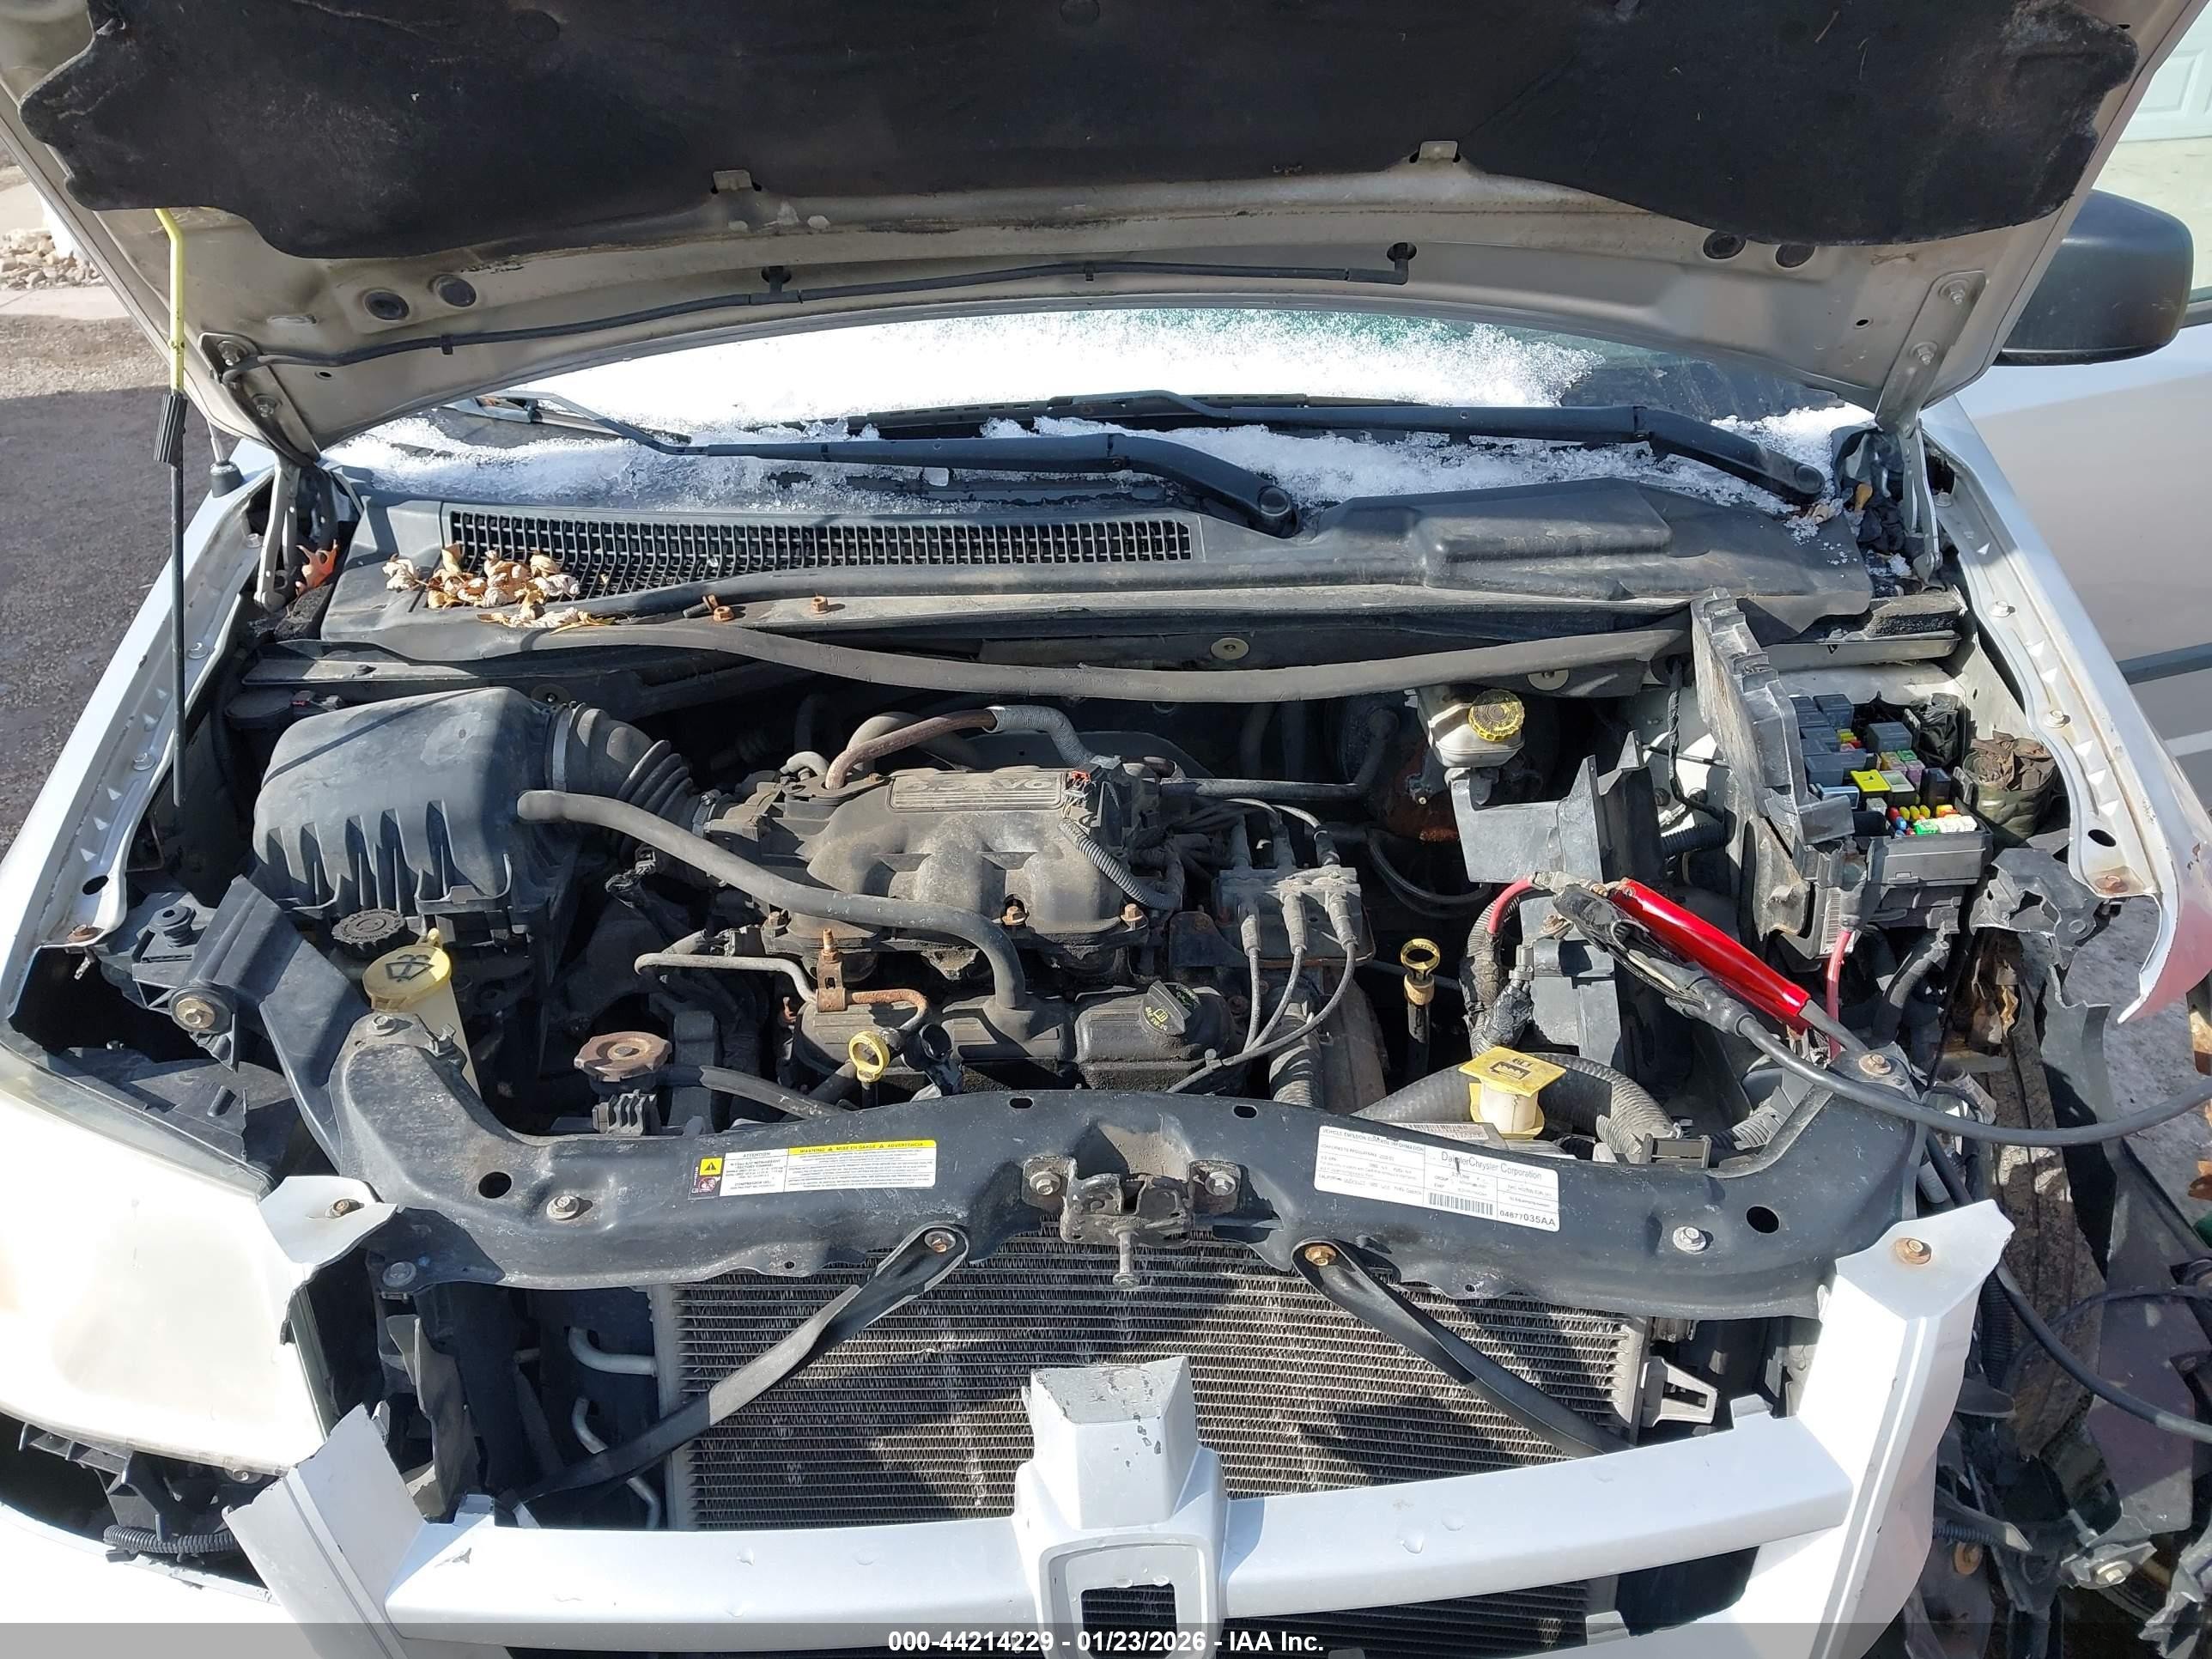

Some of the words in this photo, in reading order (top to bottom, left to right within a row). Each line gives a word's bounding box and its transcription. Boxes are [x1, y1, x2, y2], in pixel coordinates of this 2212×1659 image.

[997, 777, 1053, 789] V6
[1145, 1006, 1155, 1018] SAE
[1322, 1127, 1343, 1136] VEHICLE
[1344, 1131, 1367, 1140] EMISSION
[1500, 1162, 1542, 1179] Corporation
